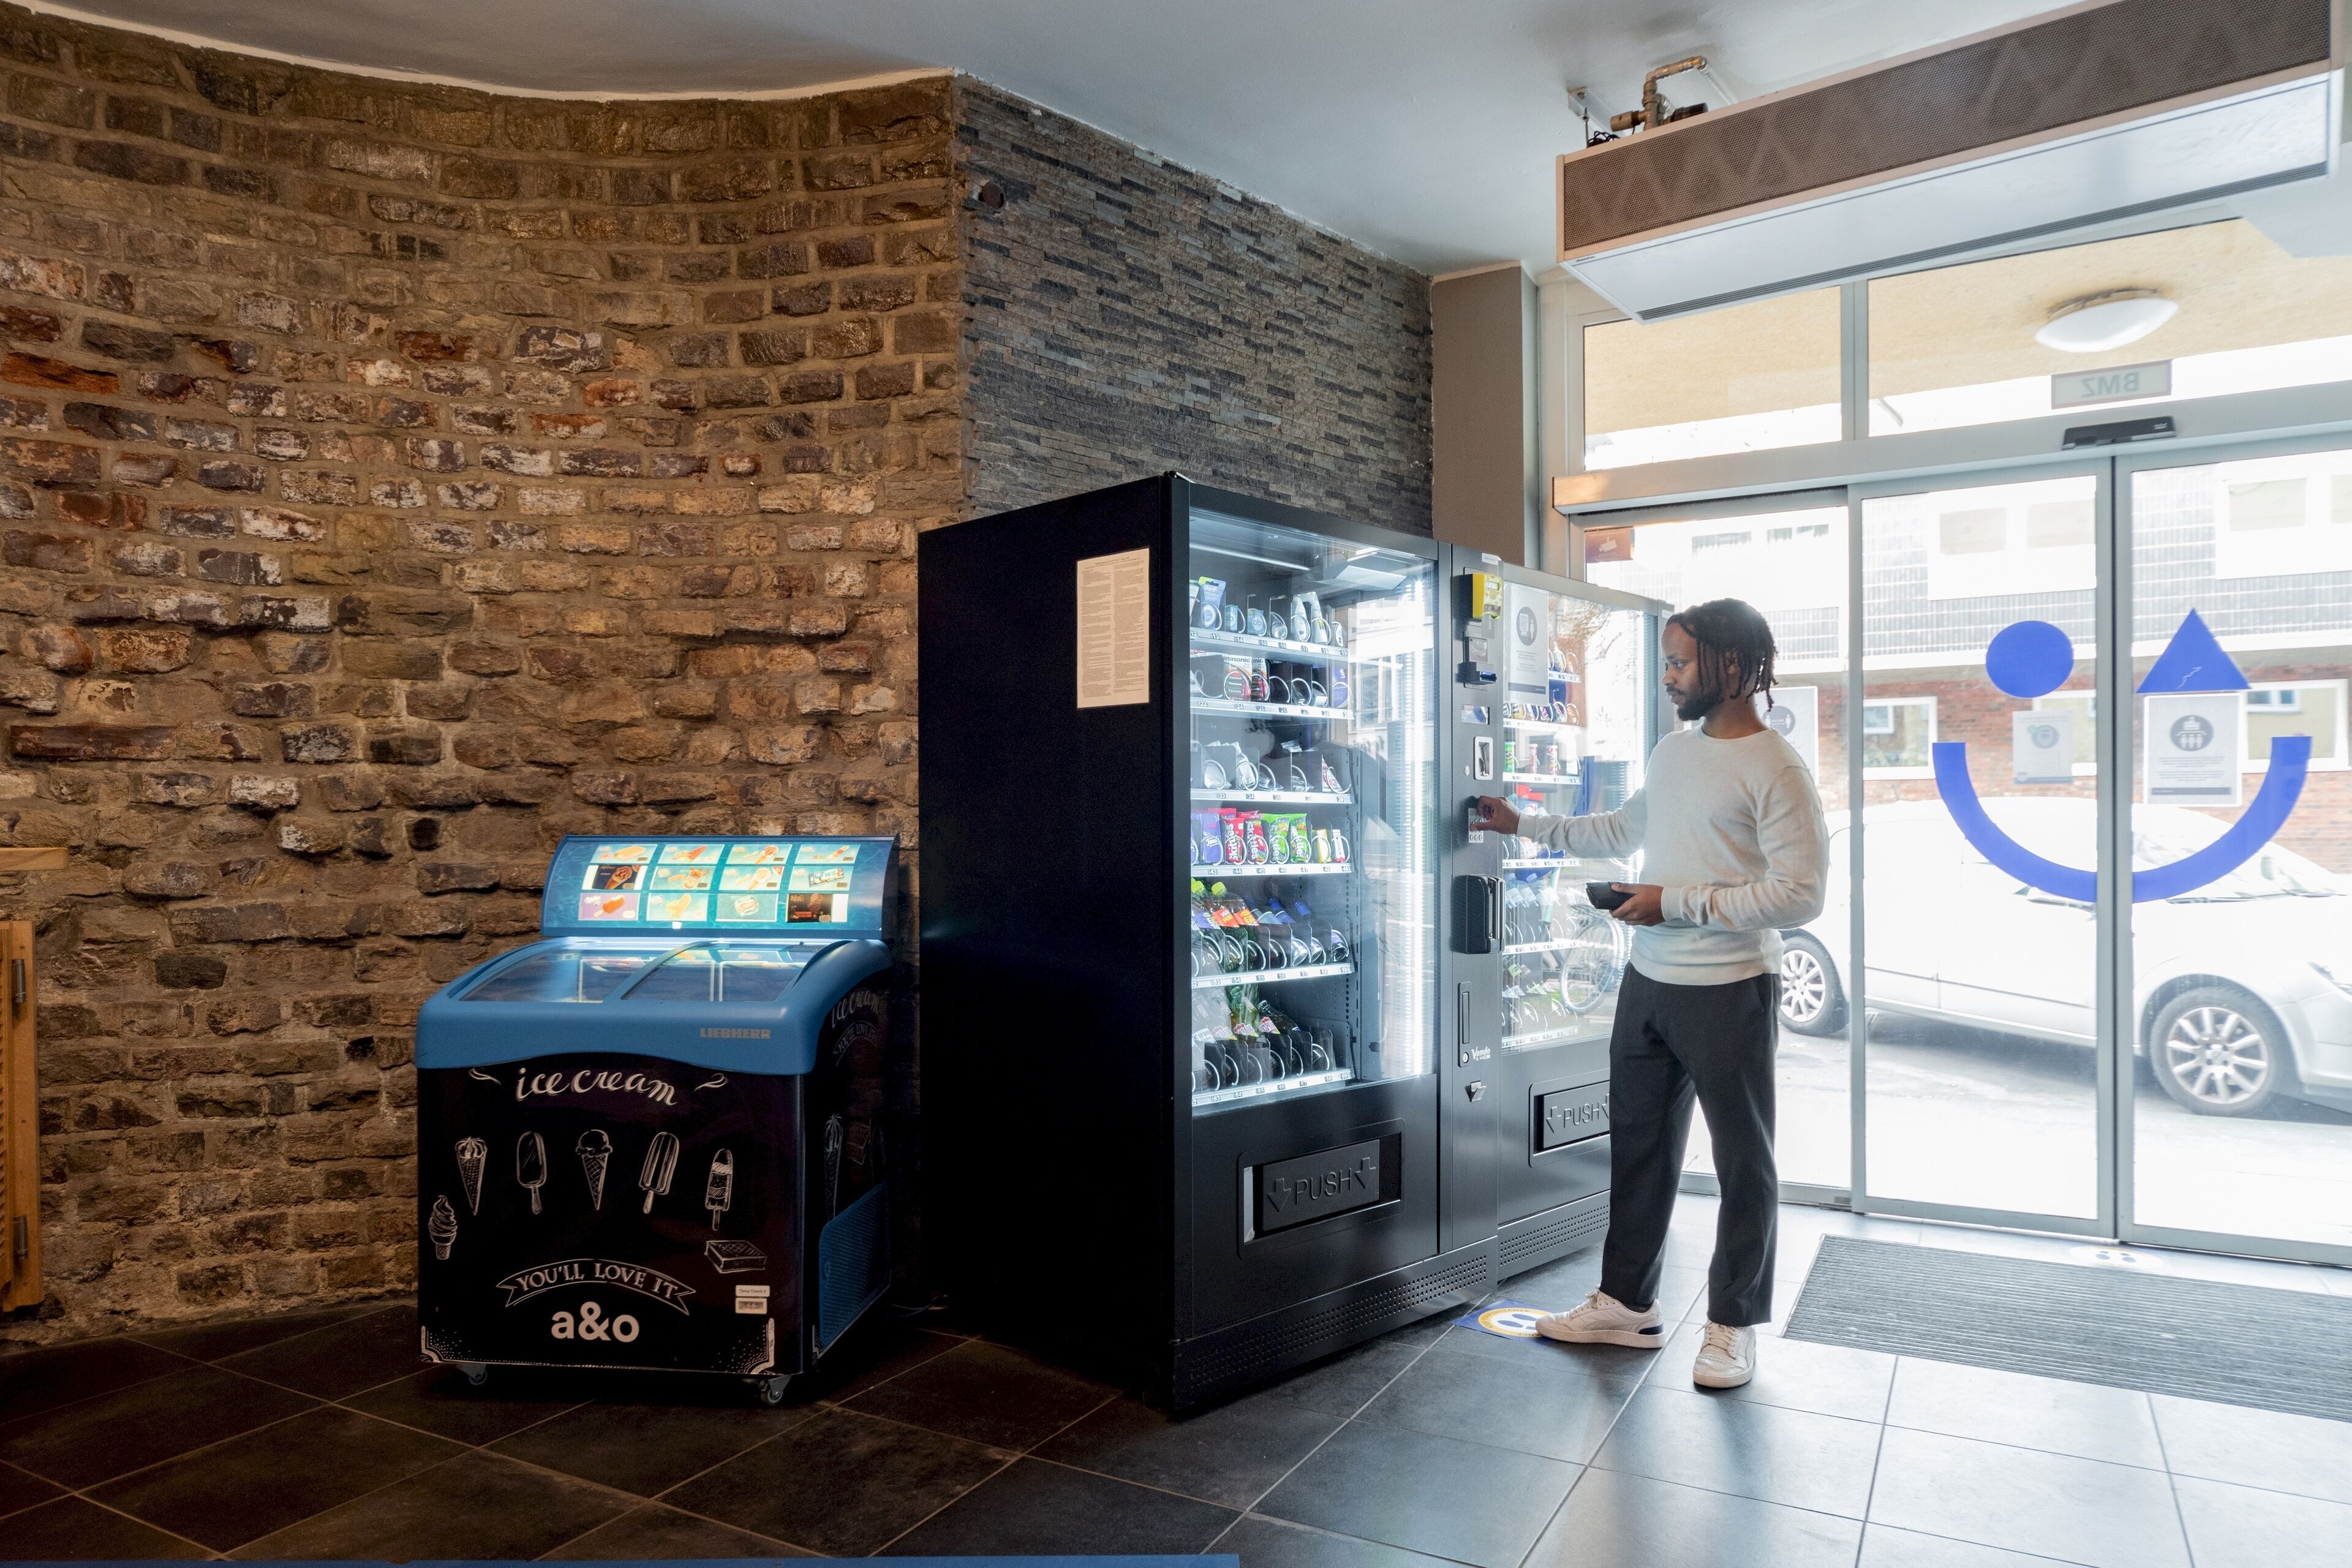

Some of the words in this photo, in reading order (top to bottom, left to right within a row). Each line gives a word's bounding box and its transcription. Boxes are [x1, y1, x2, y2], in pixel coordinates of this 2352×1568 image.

[700, 1028, 771, 1039] LIEBHERR
[1471, 1046, 1490, 1060] Vendo
[516, 1067, 570, 1101] ice
[571, 1069, 677, 1106] cream
[1564, 1101, 1600, 1128] PUSH
[1294, 1167, 1352, 1205] PUSH
[516, 1264, 584, 1291] YOU'LL
[594, 1263, 647, 1287] LOVE
[652, 1278, 678, 1298] IT
[551, 1301, 639, 1343] a&o
